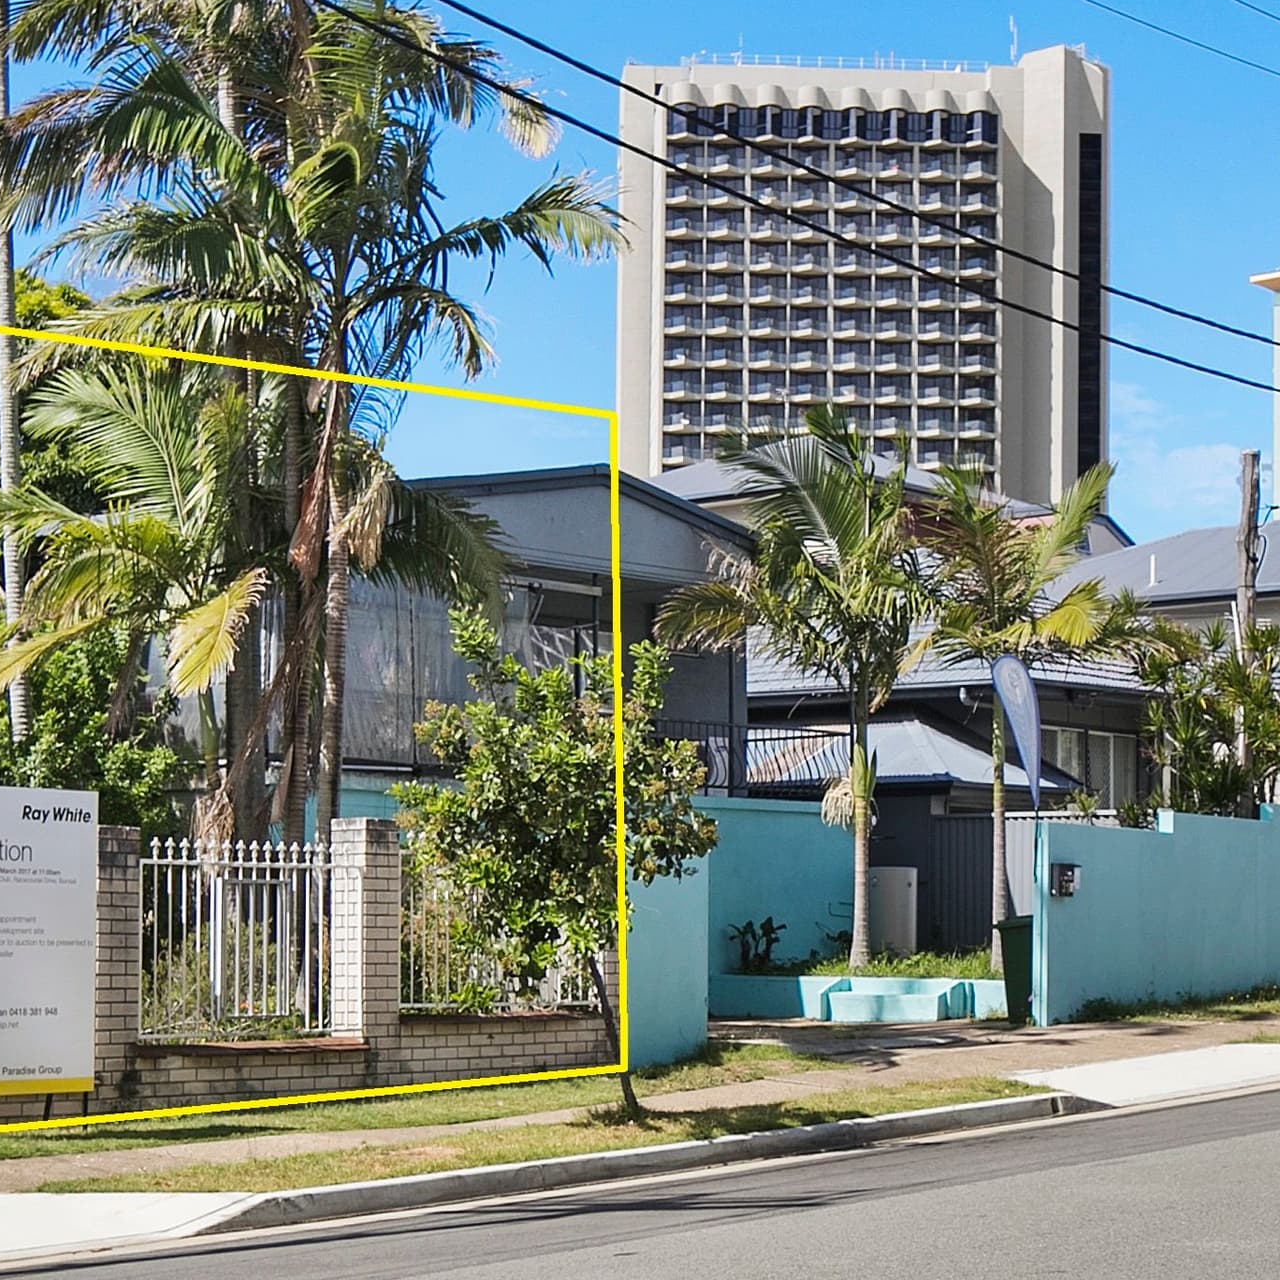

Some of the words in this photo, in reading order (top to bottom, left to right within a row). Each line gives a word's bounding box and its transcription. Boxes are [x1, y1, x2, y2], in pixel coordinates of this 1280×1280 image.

[22, 805, 50, 824] Ray
[53, 807, 91, 823] White
[0, 867, 17, 875] March
[18, 868, 32, 876] 2017
[15, 939, 37, 947] auction
[46, 939, 55, 947] be
[55, 939, 86, 947] presented
[8, 1008, 28, 1016] 0418
[29, 1007, 42, 1016] 381
[44, 1007, 58, 1016] 948
[2, 1066, 36, 1076] Paradise
[38, 1065, 63, 1075] Group
